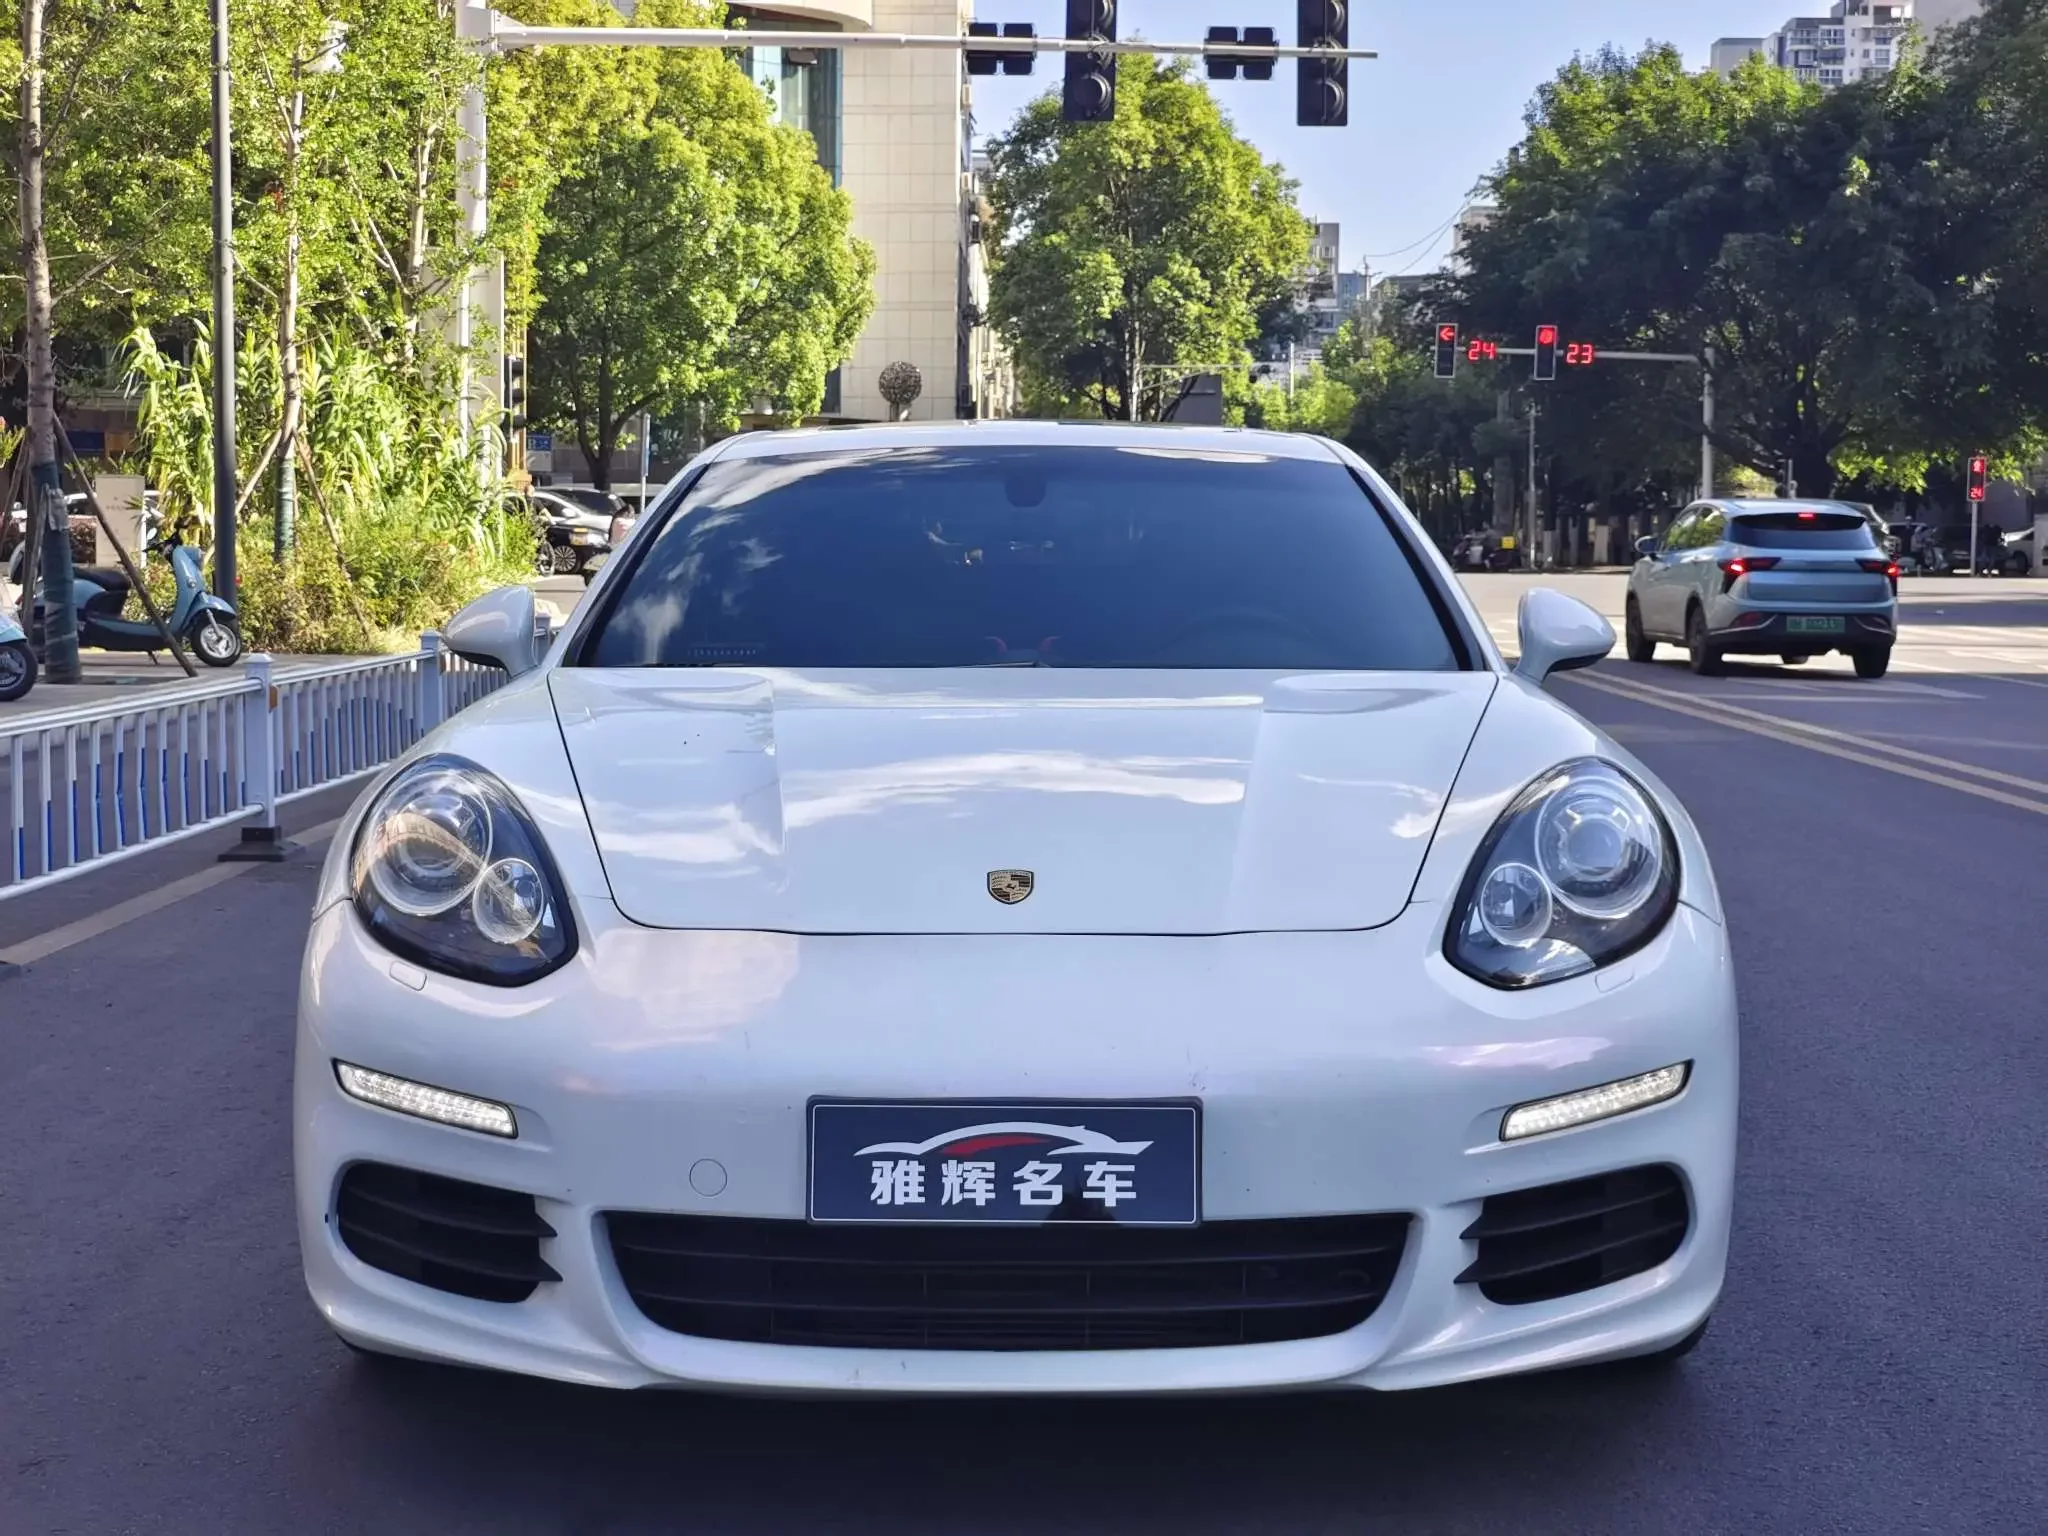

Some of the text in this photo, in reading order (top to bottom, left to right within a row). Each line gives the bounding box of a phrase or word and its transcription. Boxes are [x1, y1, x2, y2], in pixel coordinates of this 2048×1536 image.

[1469, 340, 1495, 360] 24
[1566, 343, 1593, 364] 23
[870, 1159, 1136, 1207] 雅辉名车
